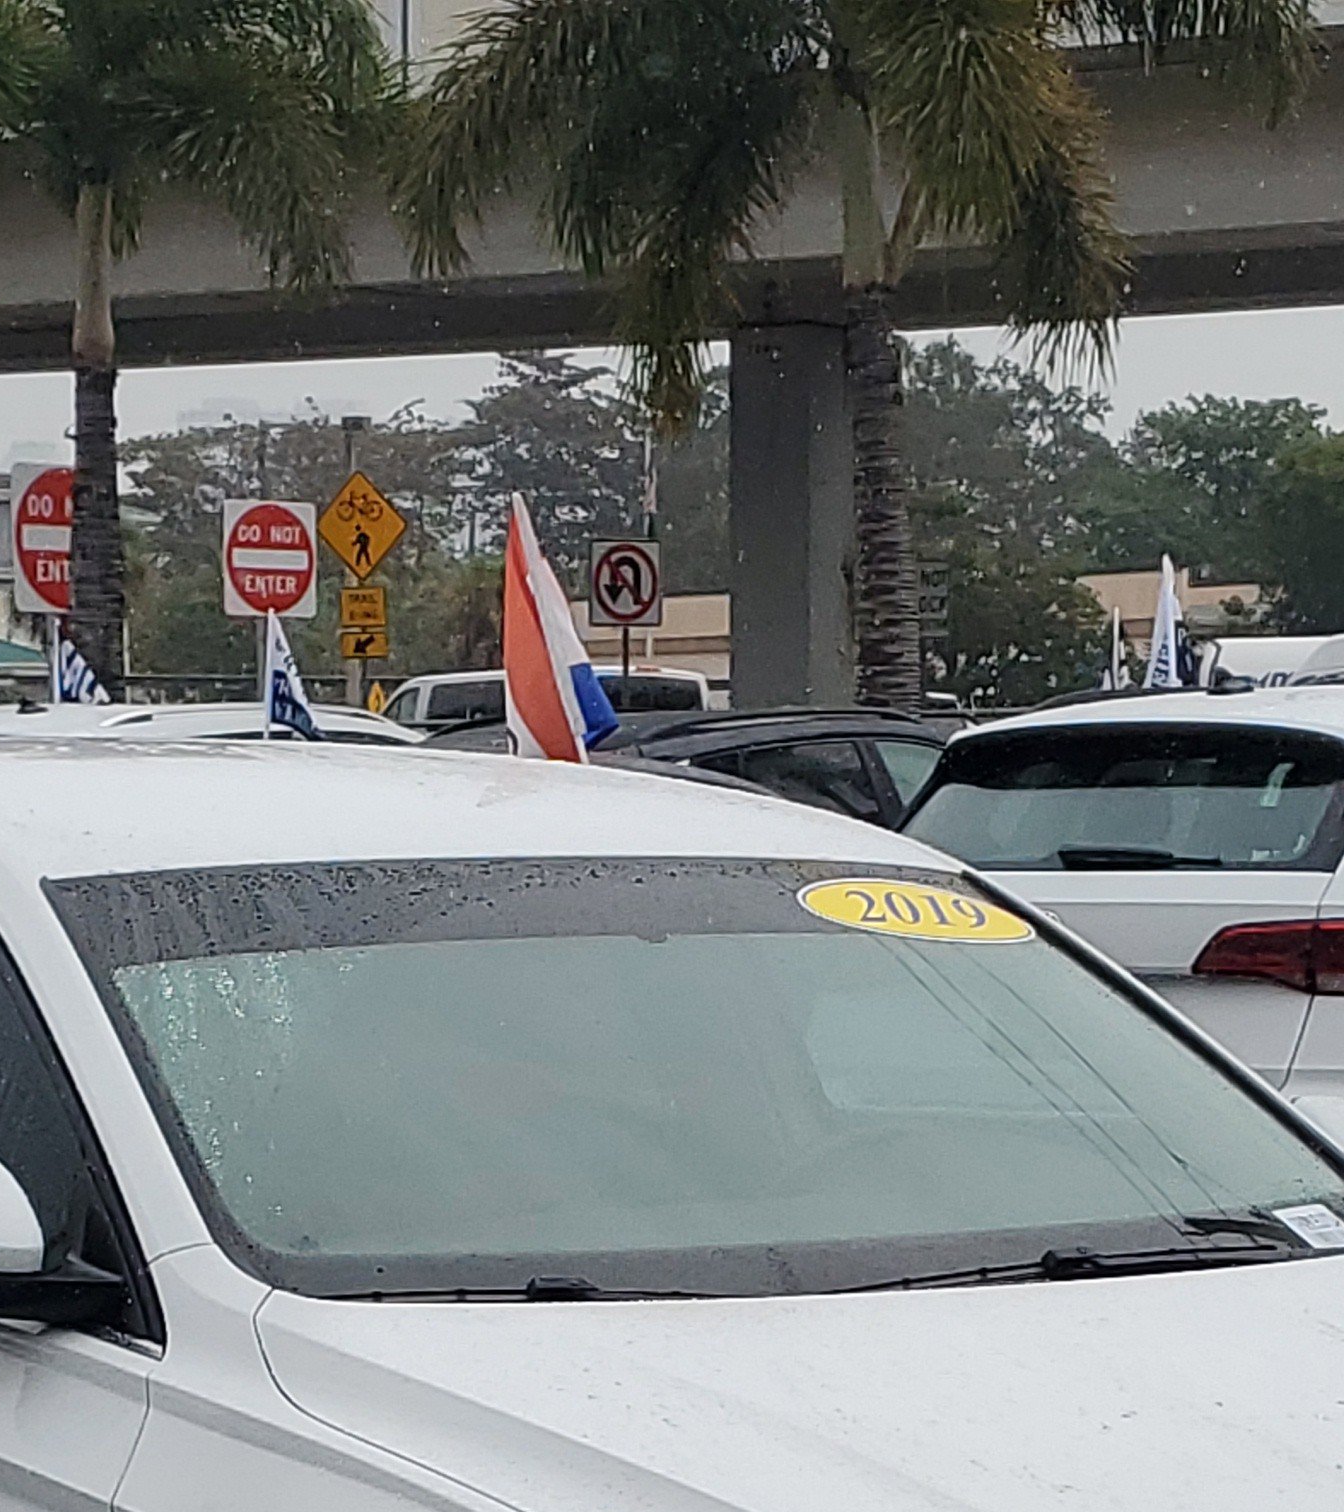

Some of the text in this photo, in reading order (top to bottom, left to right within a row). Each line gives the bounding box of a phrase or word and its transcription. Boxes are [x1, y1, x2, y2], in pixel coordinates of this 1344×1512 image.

[27, 494, 53, 518] DO
[237, 524, 302, 545] DO NOT
[37, 559, 71, 583] ENT
[244, 574, 297, 595] ENTER
[844, 889, 987, 929] 2019
